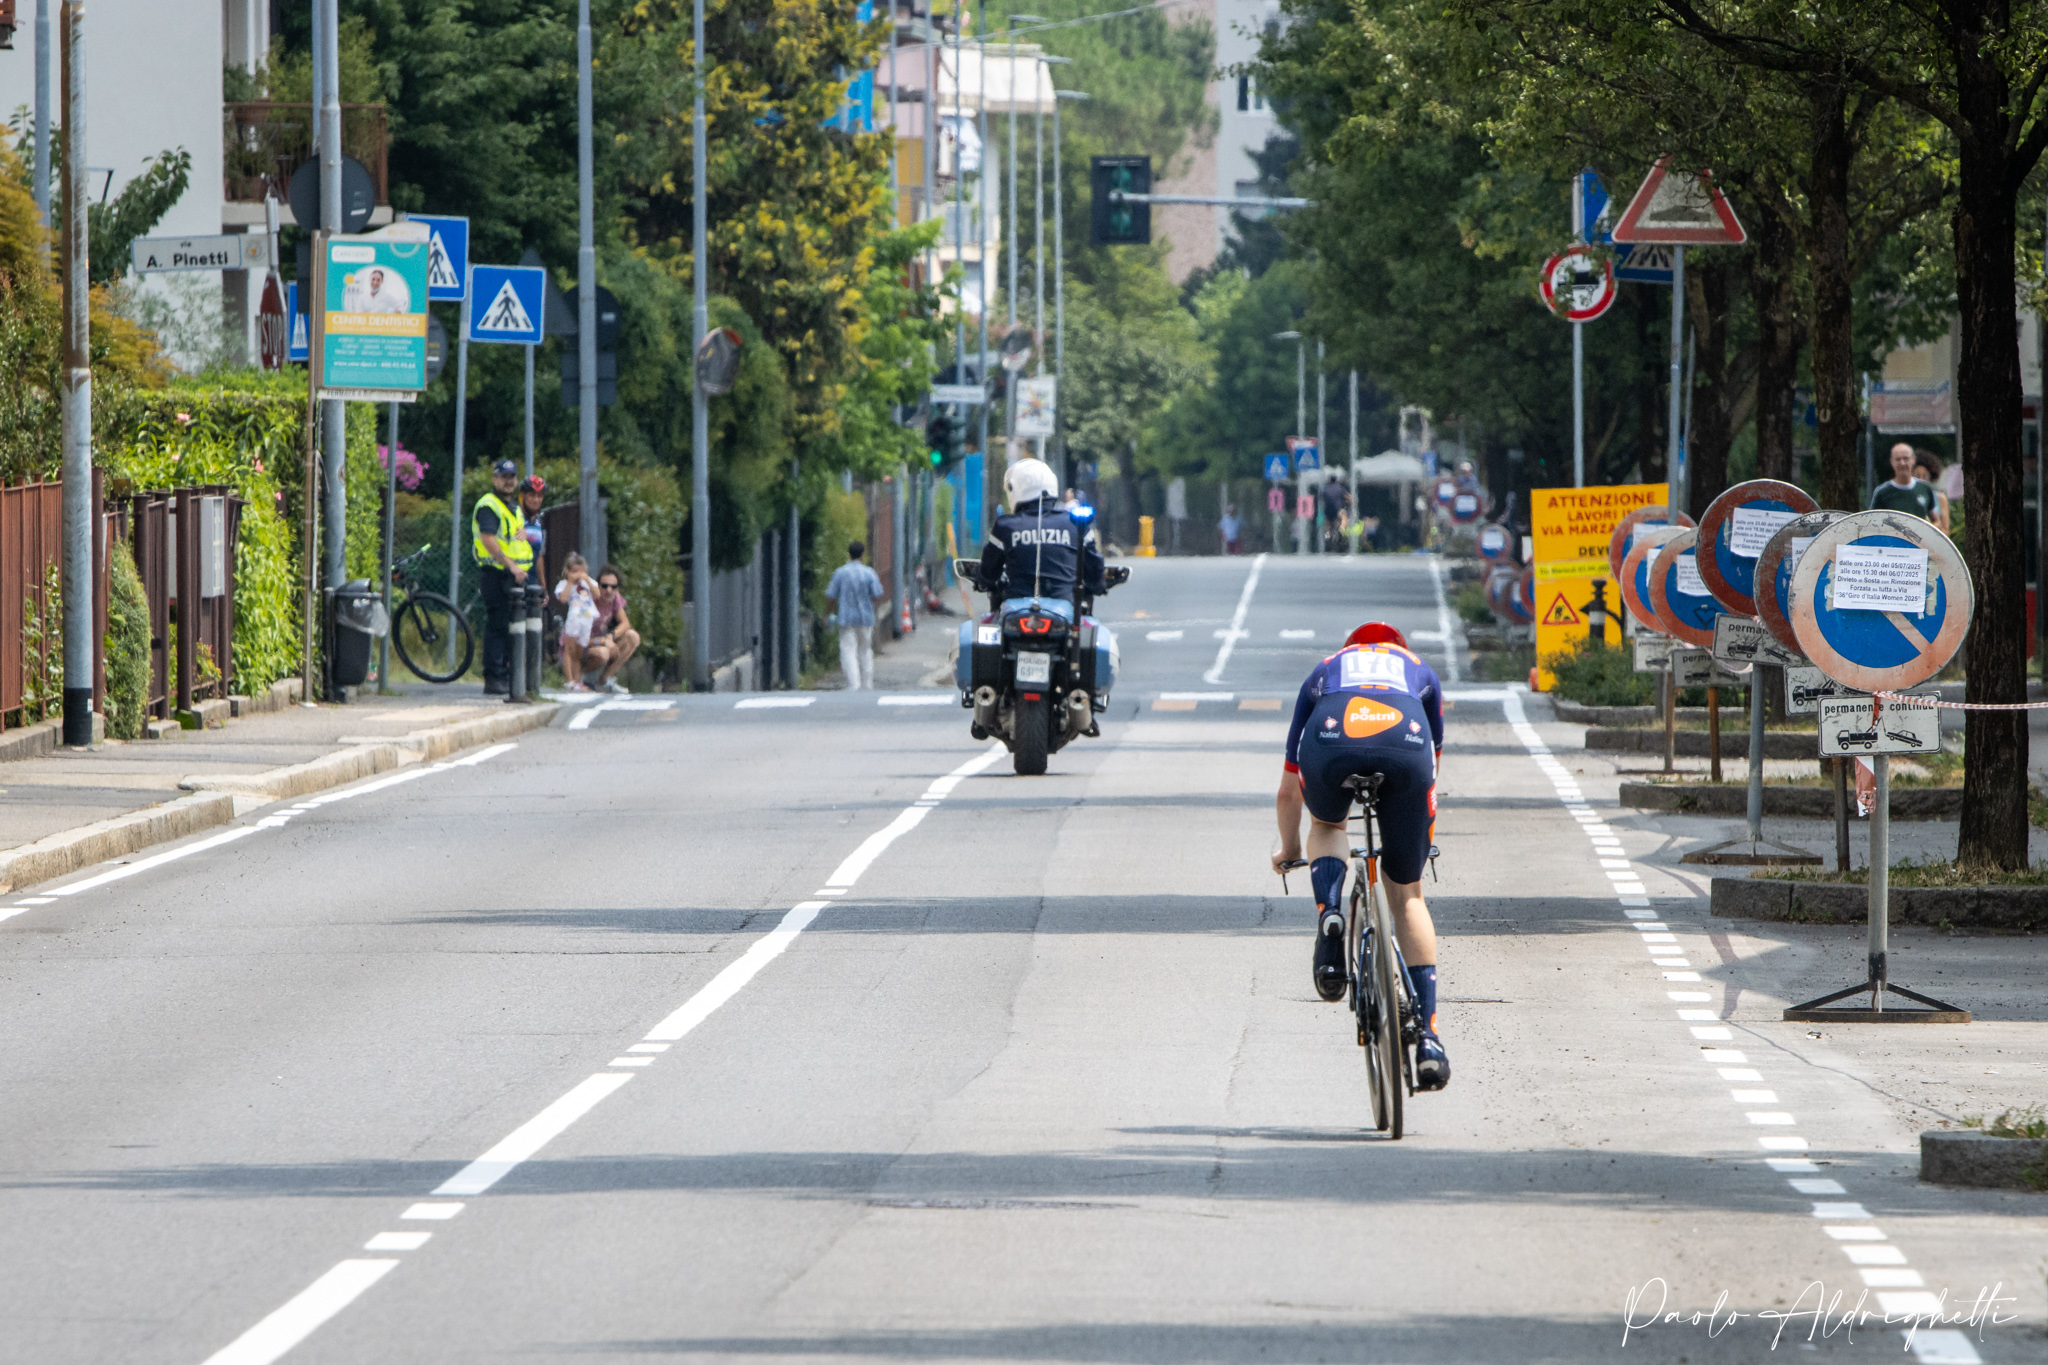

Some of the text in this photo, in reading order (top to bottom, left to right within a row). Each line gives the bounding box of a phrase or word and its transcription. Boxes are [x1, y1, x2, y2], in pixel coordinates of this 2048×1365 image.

[147, 251, 228, 268] A. Pinetti
[332, 315, 419, 327] CENTRI DENTISTICI
[261, 313, 284, 355] STOP
[1548, 491, 1656, 508] ATTENZIONE
[1567, 510, 1617, 522] LAVORI
[1541, 524, 1615, 536] VIA MARZA
[1012, 529, 1071, 547] POLIZIA
[1891, 578, 1921, 586] Rimozione
[1729, 624, 1769, 635] perman
[1348, 653, 1403, 677] 176
[1683, 655, 1712, 663] perma
[1825, 703, 1885, 715] permanene
[1350, 712, 1396, 723] postnl
